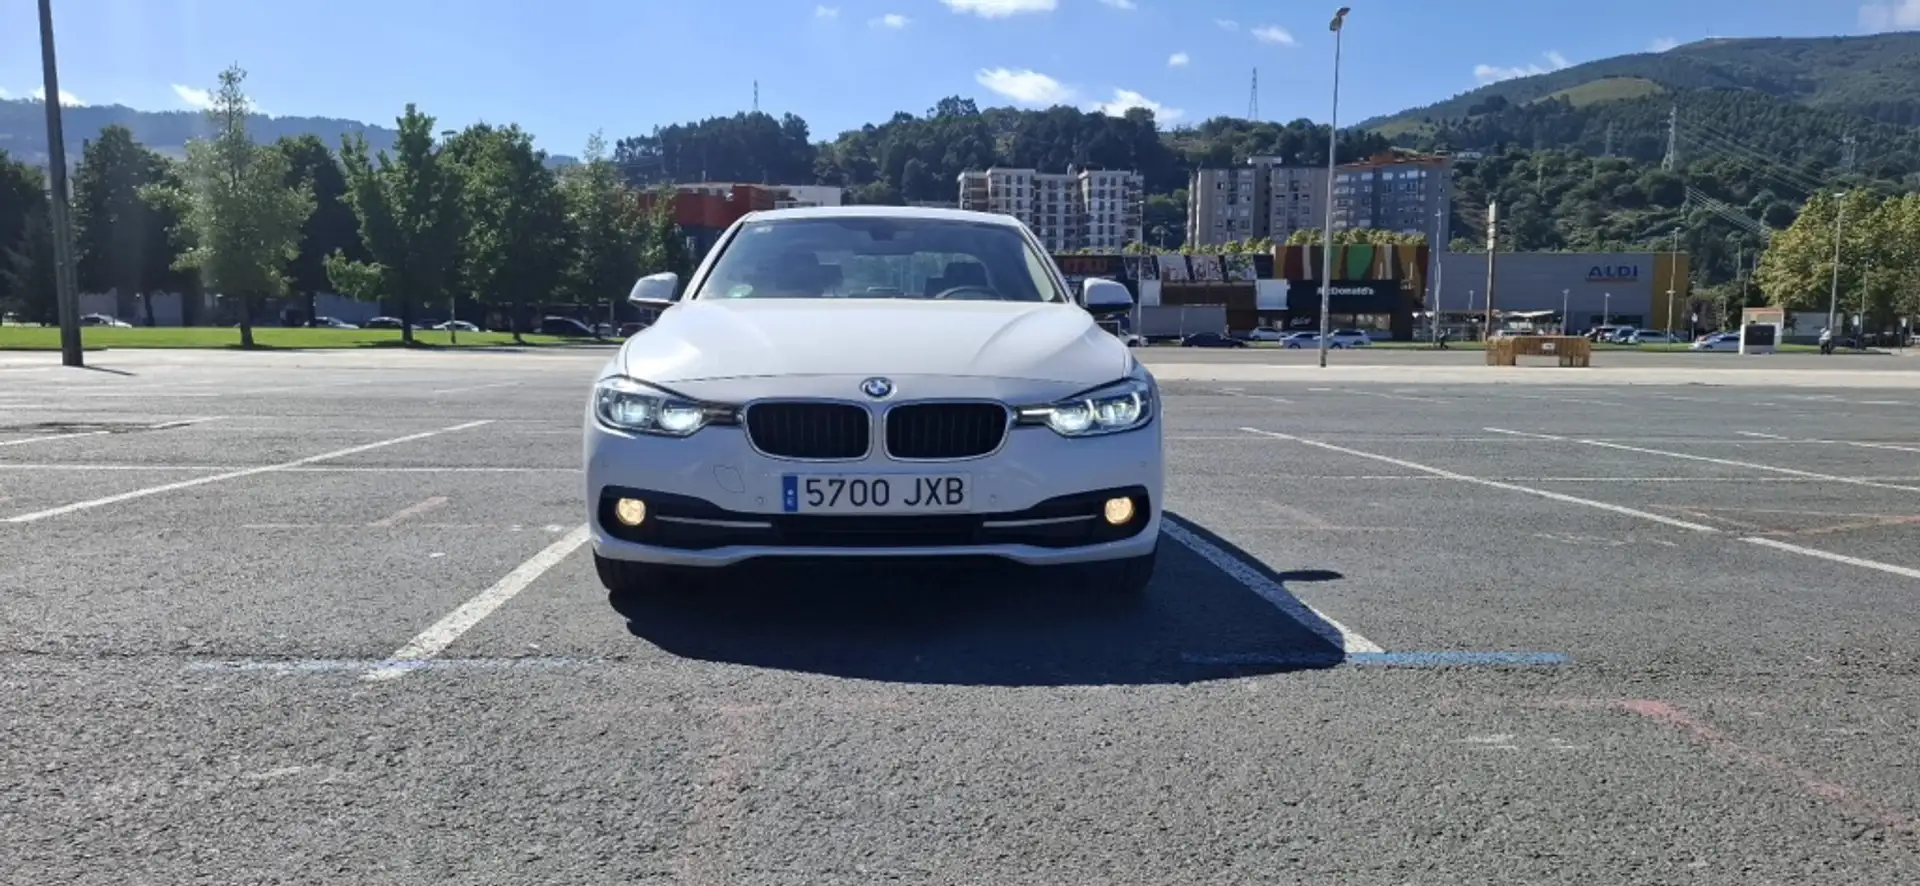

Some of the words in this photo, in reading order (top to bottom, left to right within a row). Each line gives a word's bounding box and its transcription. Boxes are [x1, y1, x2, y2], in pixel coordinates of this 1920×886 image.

[1589, 265, 1638, 277] ALDI
[805, 479, 890, 507] 5700
[903, 477, 964, 507] JXB
